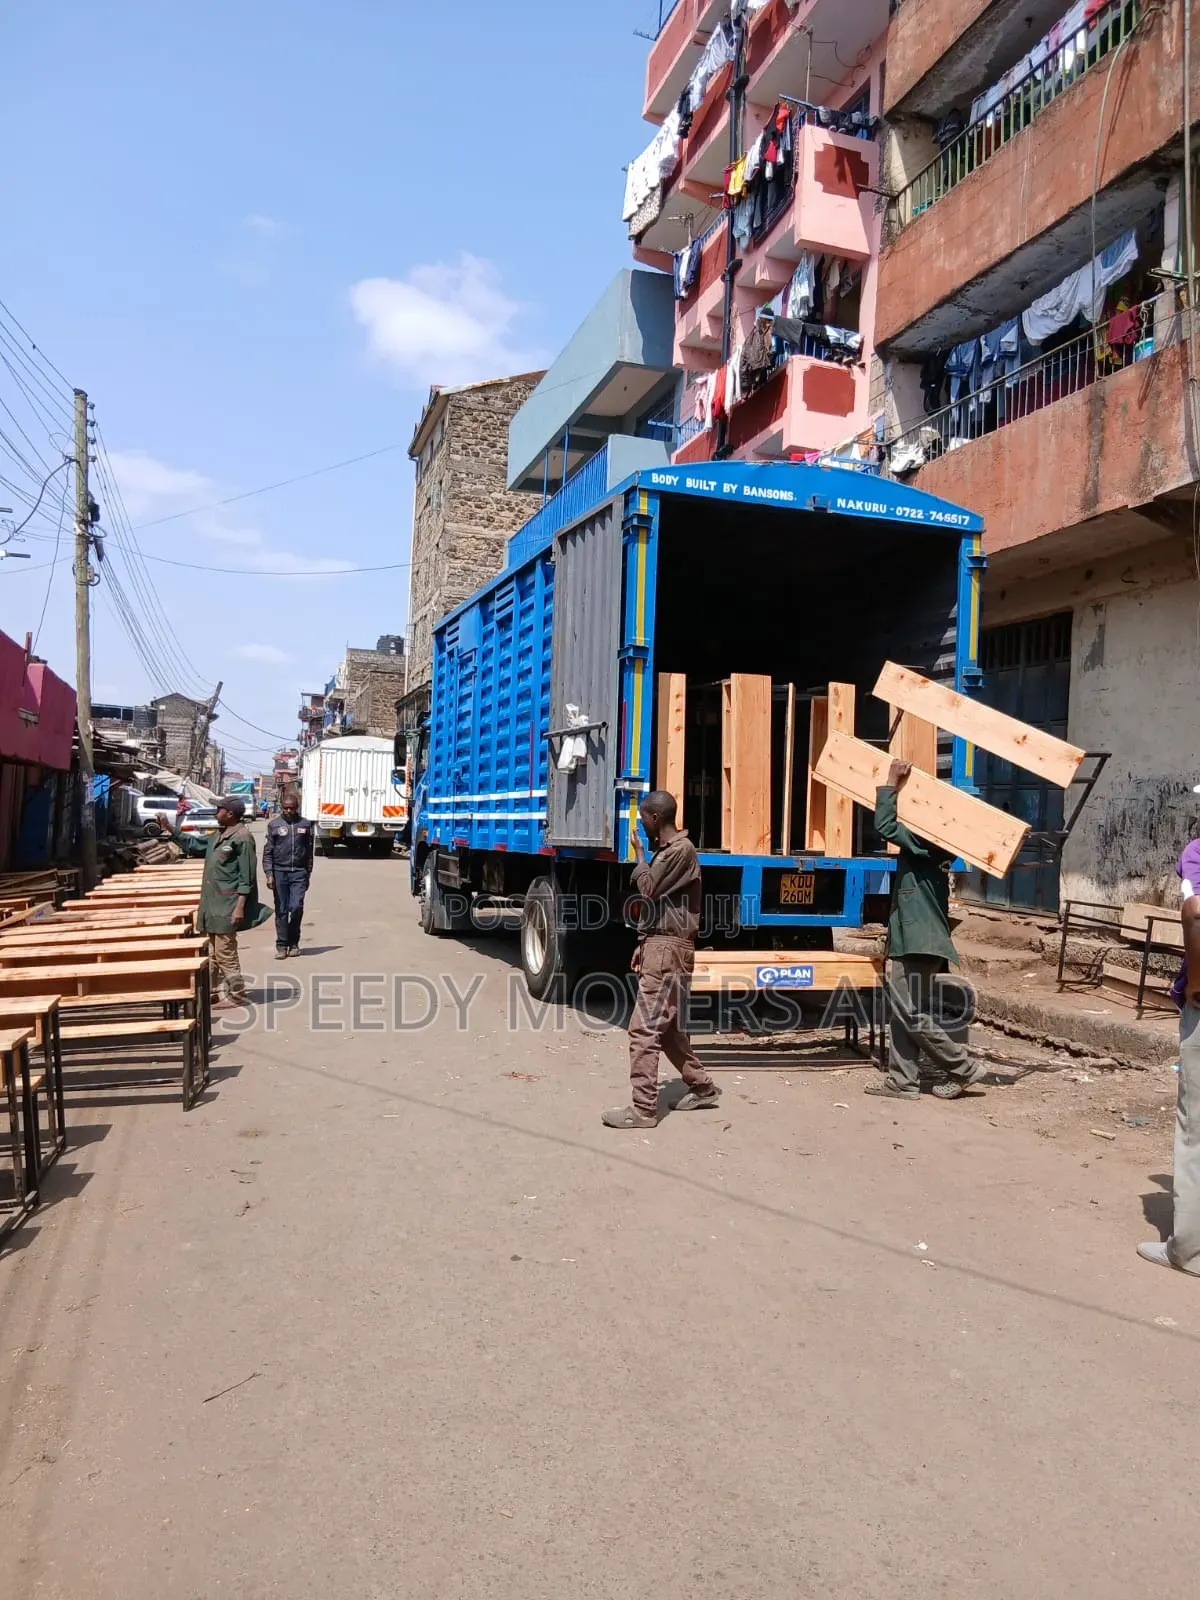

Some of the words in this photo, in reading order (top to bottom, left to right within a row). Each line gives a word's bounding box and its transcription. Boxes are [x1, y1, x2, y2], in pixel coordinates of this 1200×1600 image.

[652, 473, 679, 486] BODY
[686, 478, 717, 491] BUILT
[723, 483, 738, 494] BY
[837, 498, 887, 513] NAKURU
[789, 876, 812, 889] KDU
[782, 890, 812, 903] 260M
[780, 968, 811, 979] PLAN
